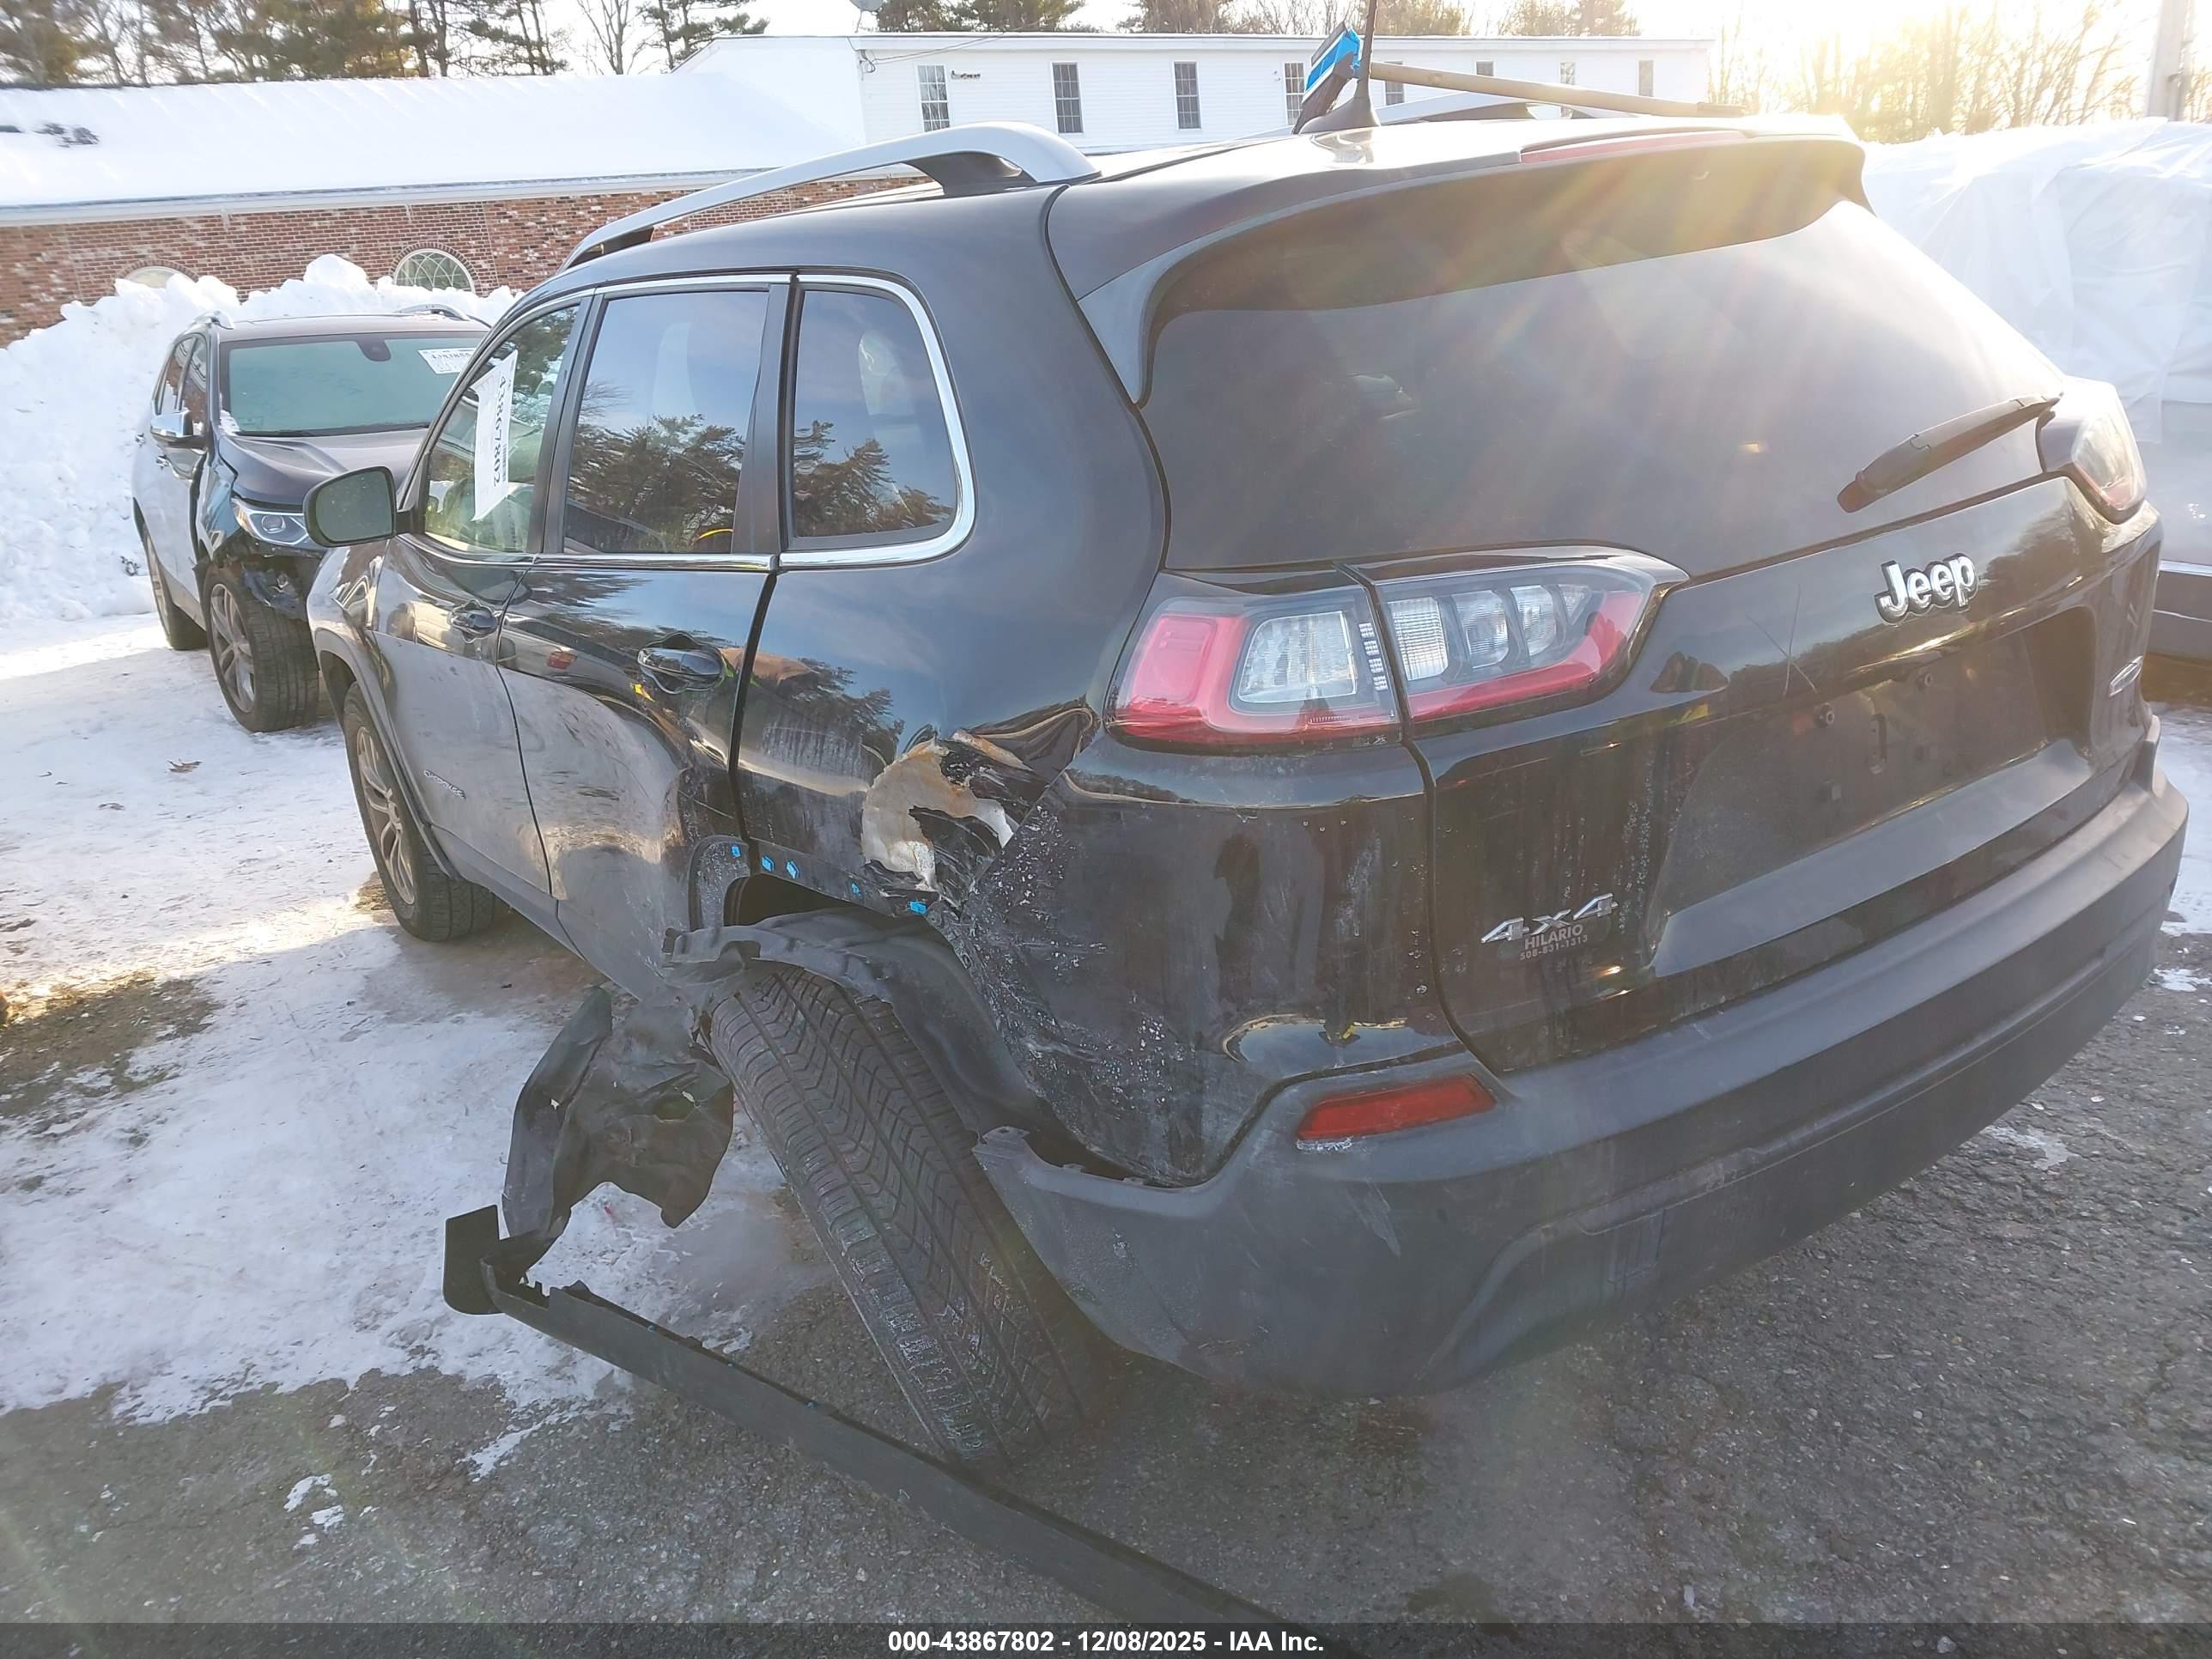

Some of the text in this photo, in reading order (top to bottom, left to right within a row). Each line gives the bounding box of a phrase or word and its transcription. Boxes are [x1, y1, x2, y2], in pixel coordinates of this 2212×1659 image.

[493, 375, 507, 488] 43867802
[1875, 552, 1978, 624] Jeep
[1524, 923, 1583, 951] HILARIO
